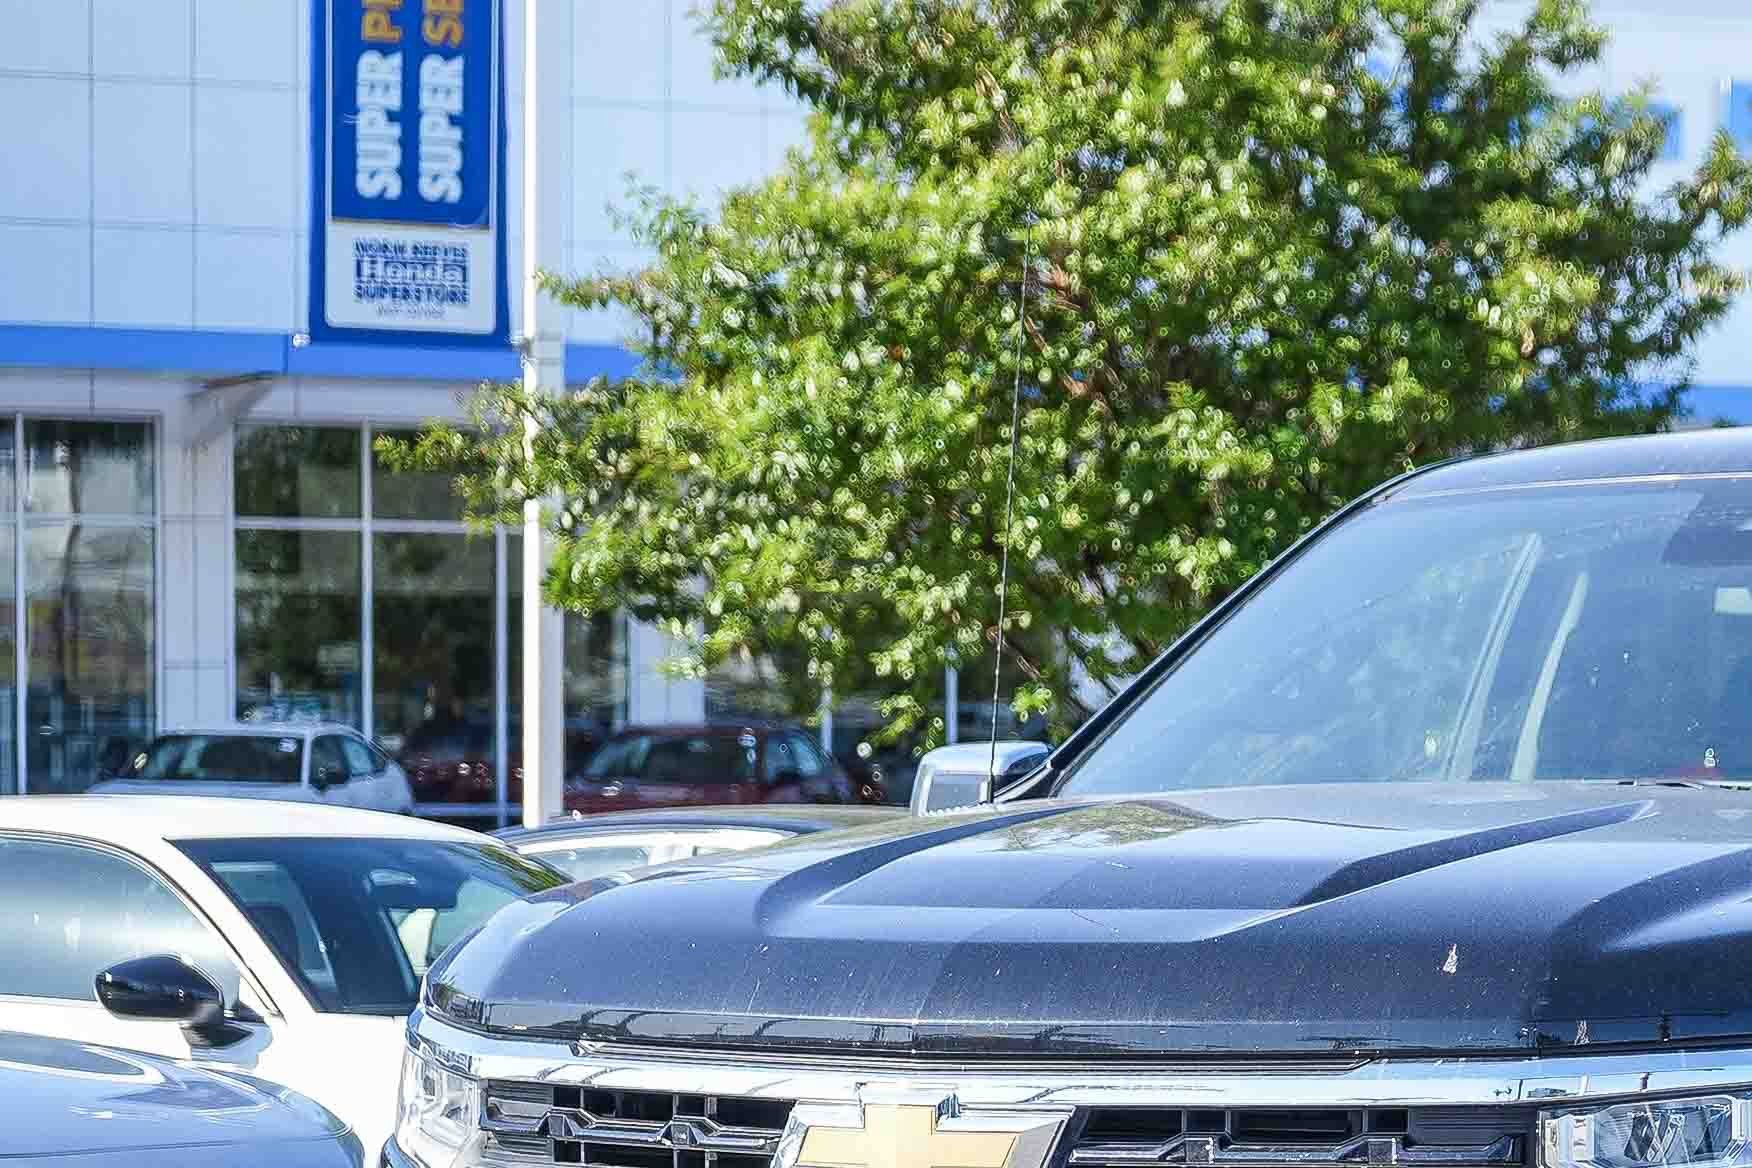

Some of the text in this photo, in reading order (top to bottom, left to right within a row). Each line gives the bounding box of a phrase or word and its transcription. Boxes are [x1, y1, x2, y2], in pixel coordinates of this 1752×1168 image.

[356, 50, 402, 199] SUPER
[419, 53, 464, 203] SUPER
[361, 259, 465, 284] Honda
